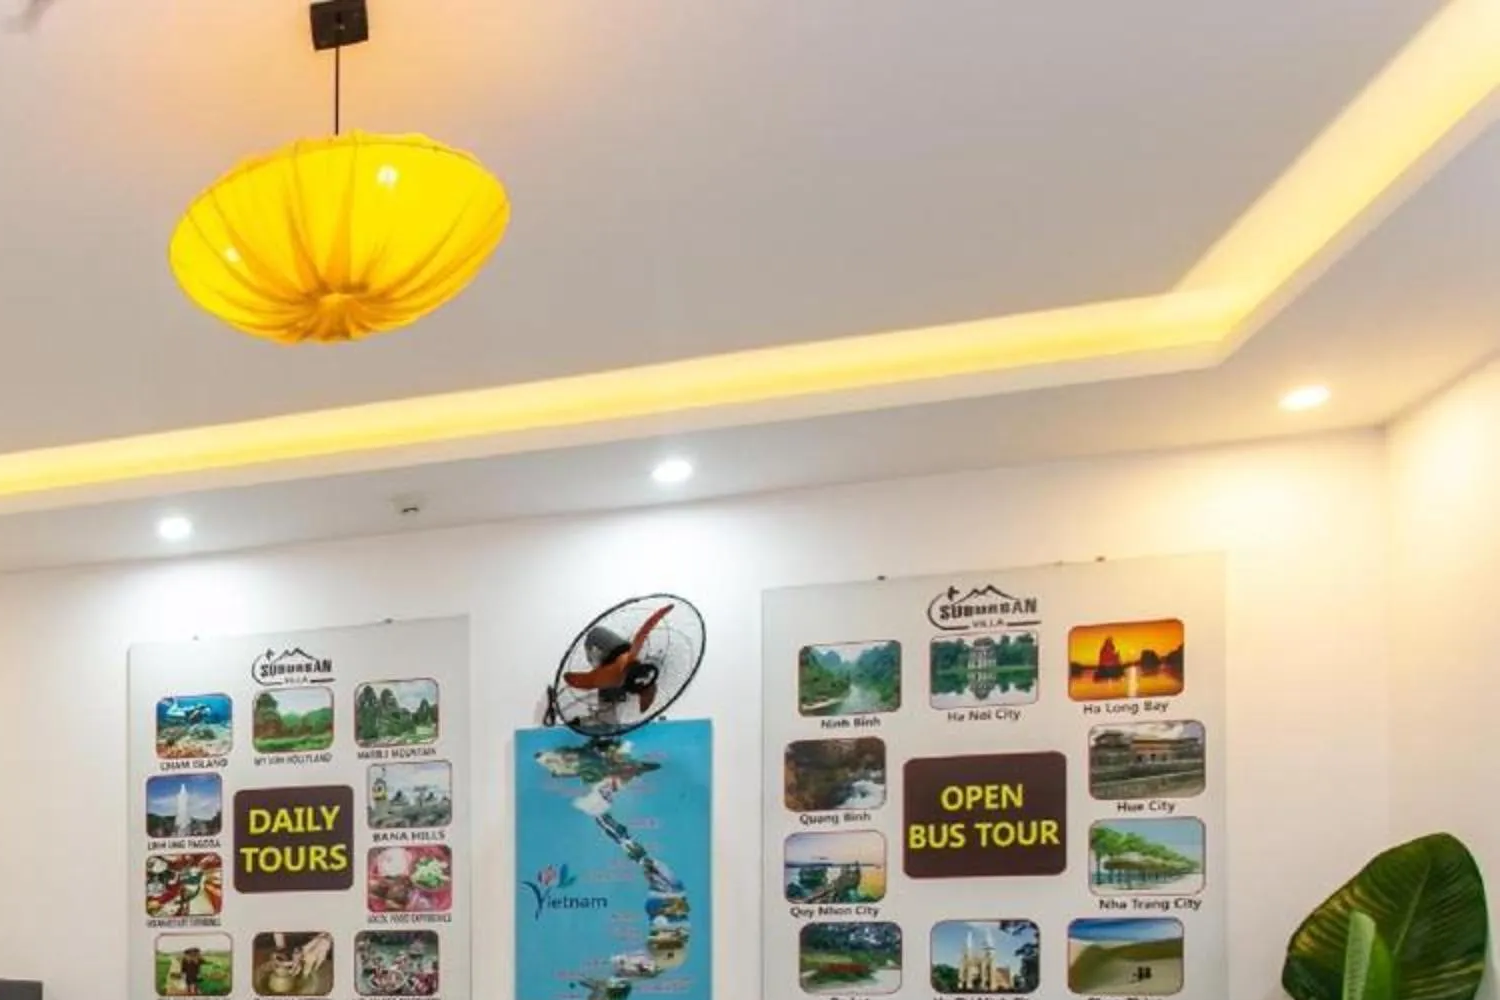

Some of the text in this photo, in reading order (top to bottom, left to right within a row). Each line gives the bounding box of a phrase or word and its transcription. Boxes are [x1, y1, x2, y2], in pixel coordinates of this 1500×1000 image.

[948, 708, 1021, 724] Ha Noi City
[1083, 700, 1169, 717] Ha Long Bay
[821, 716, 881, 729] Ninh Binh
[940, 783, 1024, 811] OPEN
[1117, 800, 1175, 814] Hue City
[248, 805, 340, 834] DAILY
[908, 819, 1060, 849] BUS TOUR
[240, 844, 348, 873] TOURS
[520, 880, 608, 922] Vietnam
[1099, 897, 1202, 912] Nha Trang City
[790, 906, 815, 918] Quy
[855, 905, 879, 918] City
